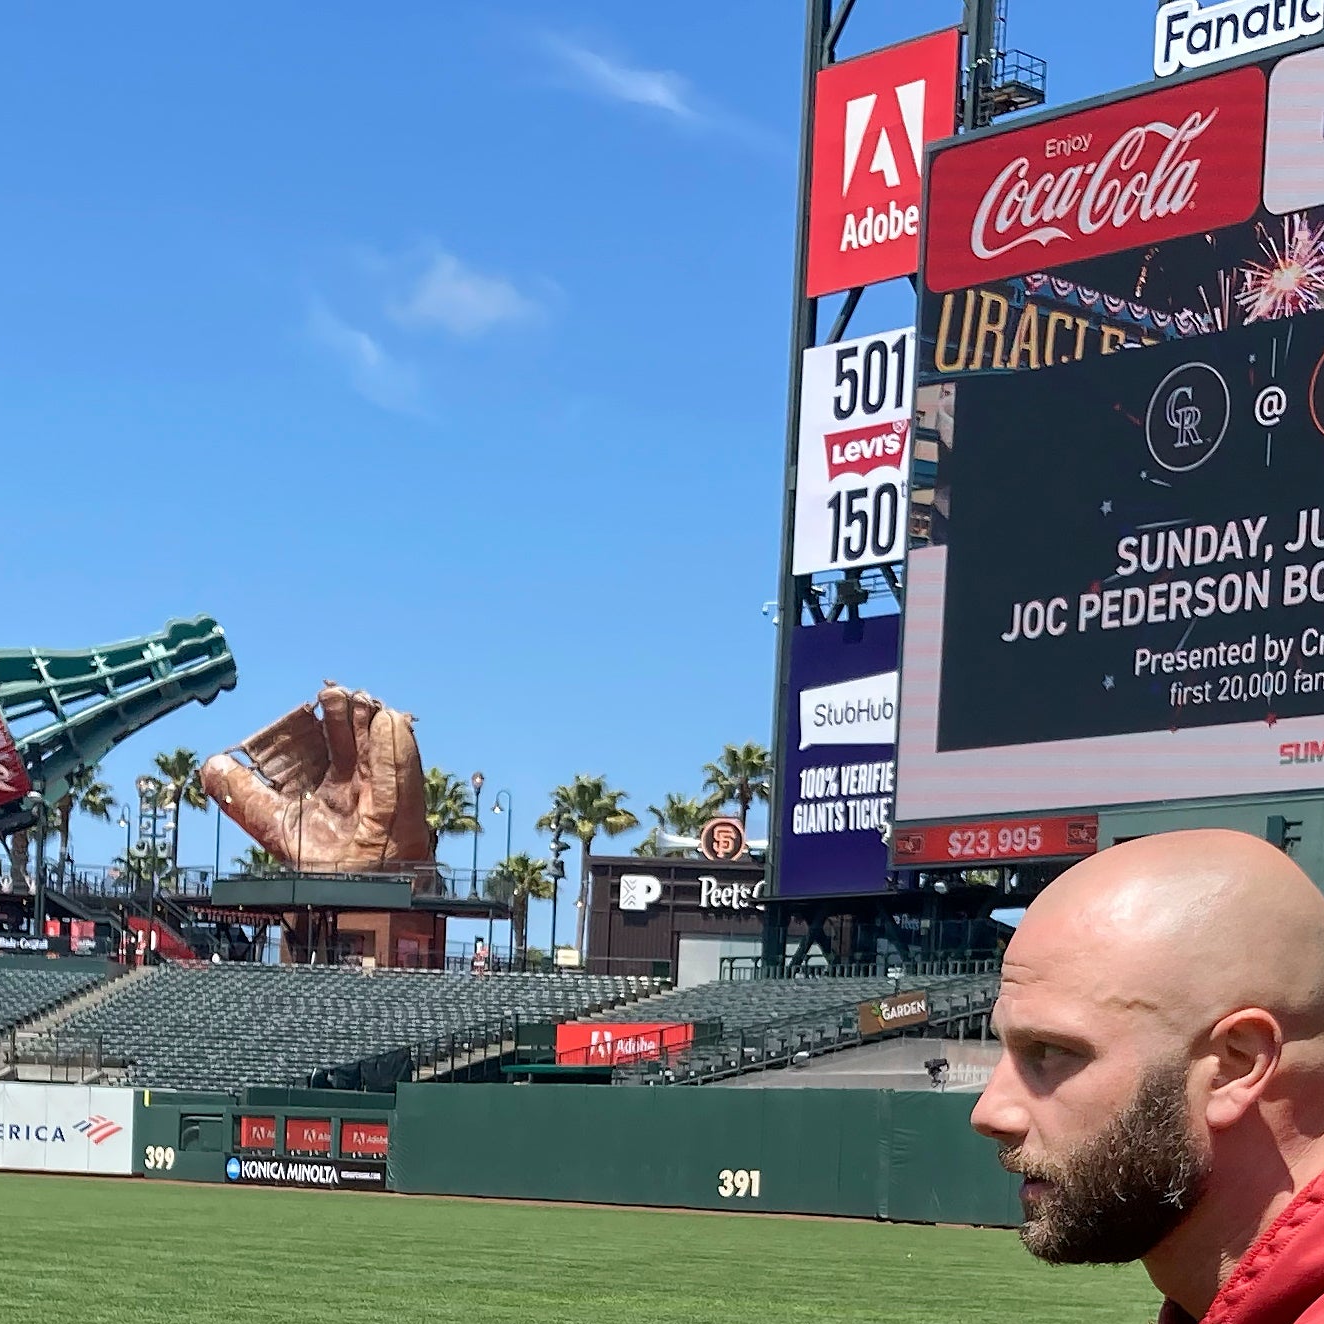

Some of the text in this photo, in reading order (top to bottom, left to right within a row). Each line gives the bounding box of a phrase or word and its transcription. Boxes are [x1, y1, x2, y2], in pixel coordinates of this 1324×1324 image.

[1164, 0, 1320, 63] Fanatic
[1045, 133, 1093, 158] Enjoy
[971, 107, 1220, 260] Coca-Cola
[840, 201, 920, 252] Adobe
[833, 334, 906, 420] 501
[1254, 385, 1287, 426] @
[1116, 516, 1273, 577] SUNDAY,
[1001, 598, 1068, 642] JOC
[1077, 568, 1271, 632] PEDERSON
[1134, 638, 1256, 676] Presented
[1266, 633, 1293, 668] by
[1169, 681, 1211, 706] first
[1218, 671, 1288, 705] 20,000
[813, 697, 893, 727] StubHub
[800, 767, 838, 799] 100%
[793, 801, 845, 834] GIANTS
[948, 825, 1042, 858] $23,995
[882, 1000, 926, 1021] GARDEN
[144, 1145, 175, 1171] 399
[241, 1160, 285, 1180] KONICA
[286, 1163, 339, 1185] MINOLTA
[718, 1169, 761, 1197] 391
